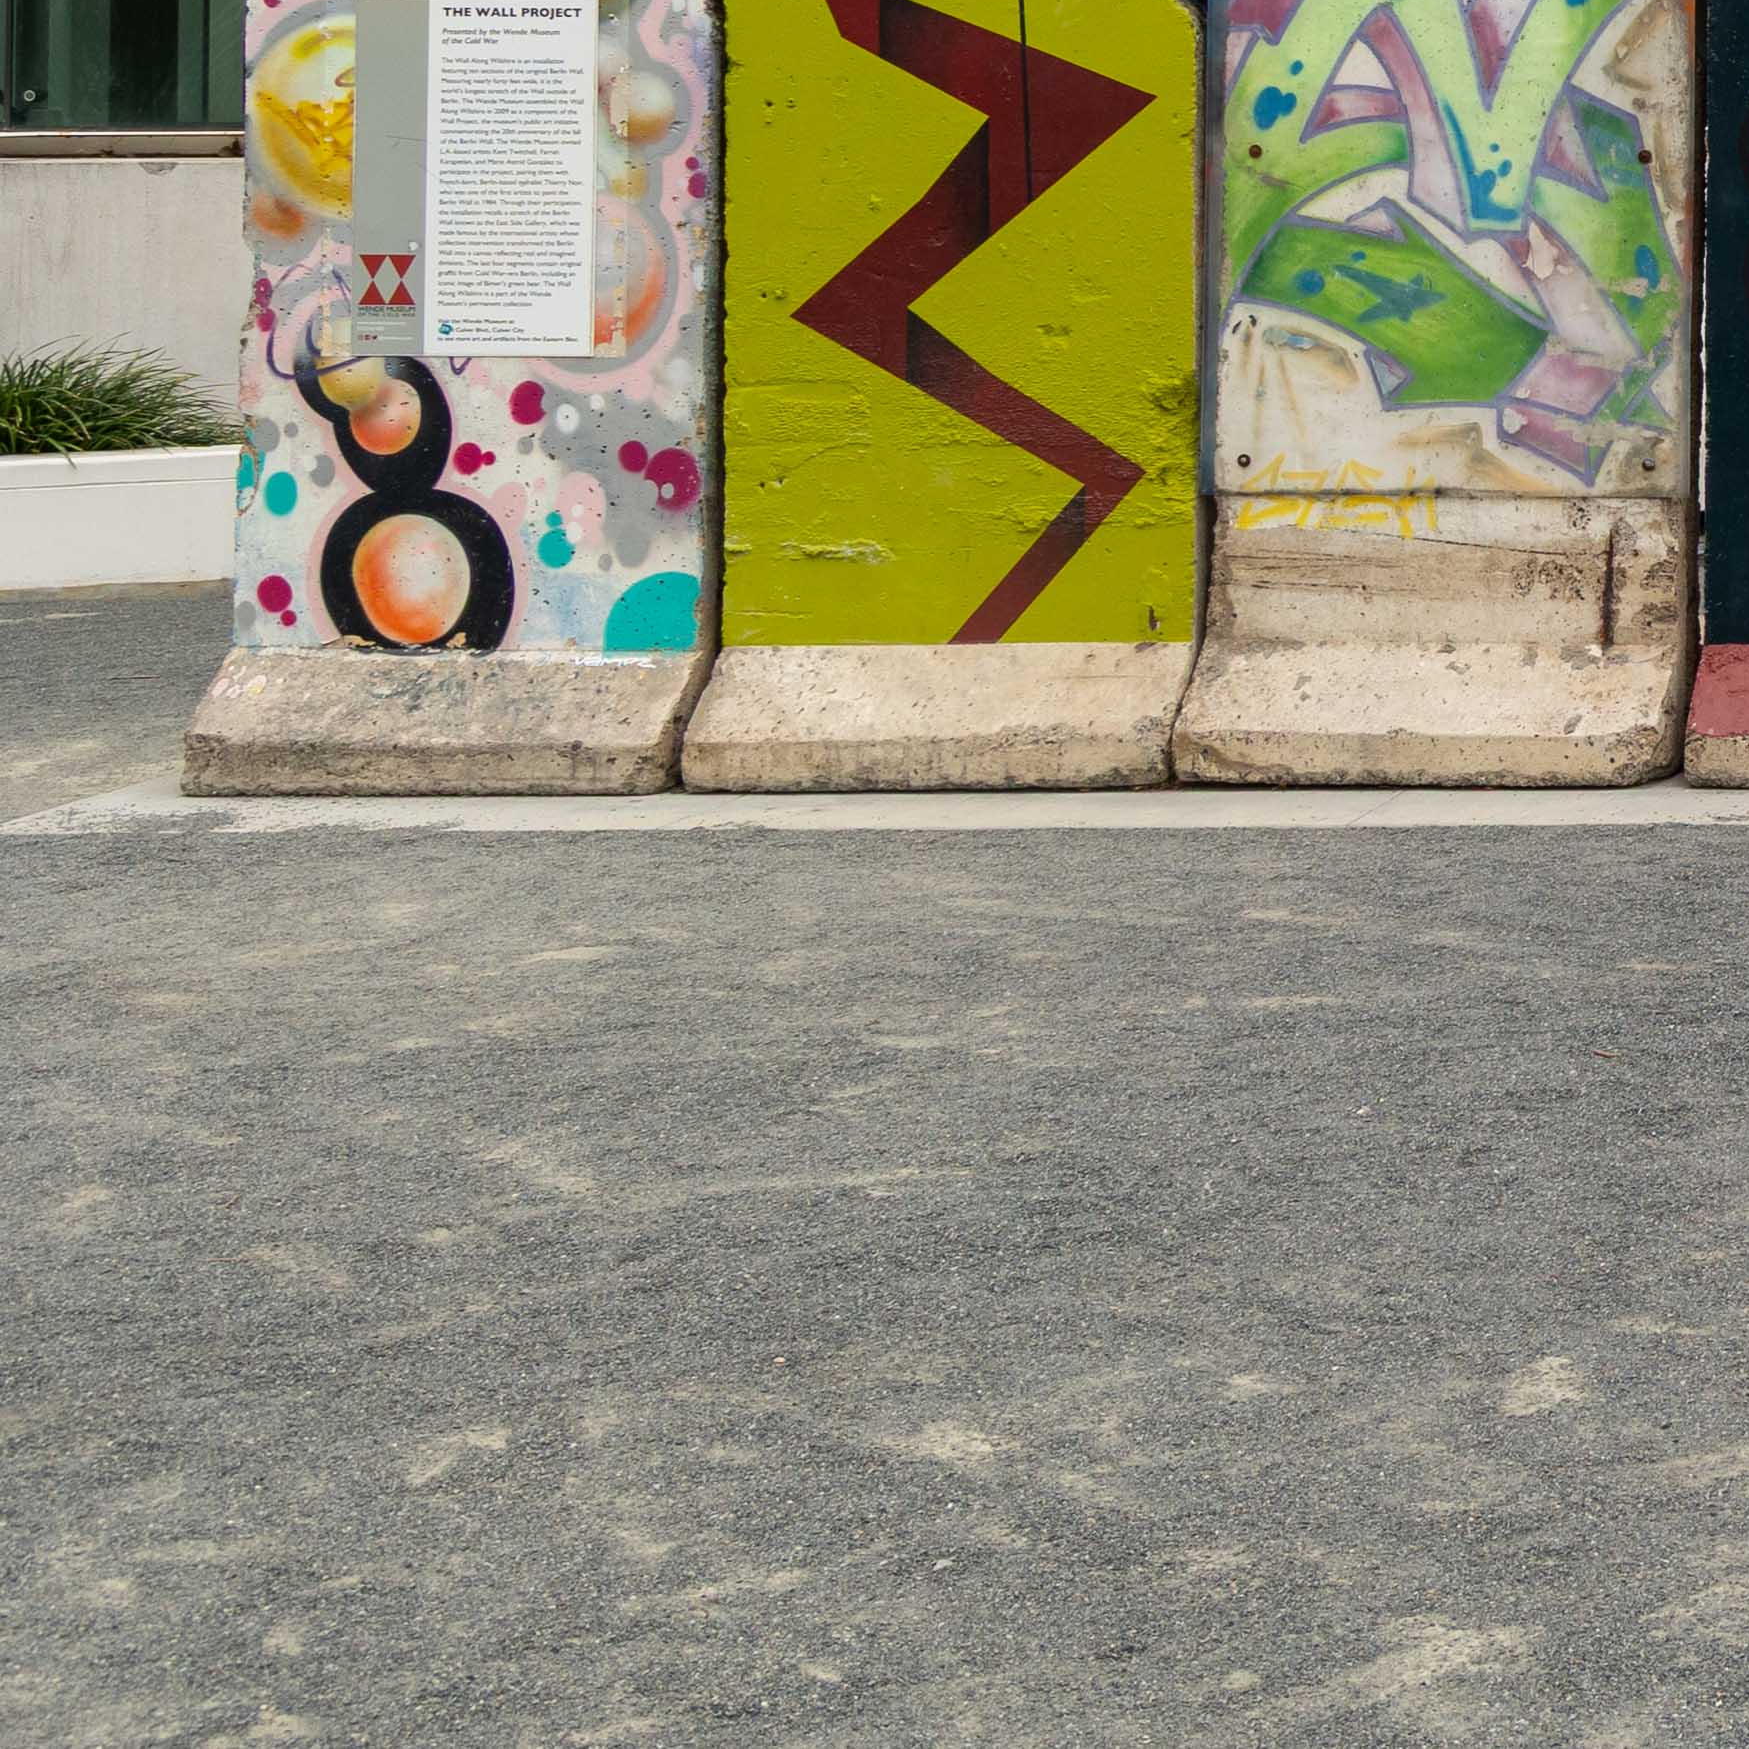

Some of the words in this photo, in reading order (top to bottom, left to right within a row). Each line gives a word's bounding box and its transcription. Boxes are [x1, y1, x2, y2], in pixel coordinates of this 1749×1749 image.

[442, 7, 471, 17] THE
[476, 7, 516, 17] WALL
[522, 7, 582, 19] PROJECT
[479, 28, 487, 37] by
